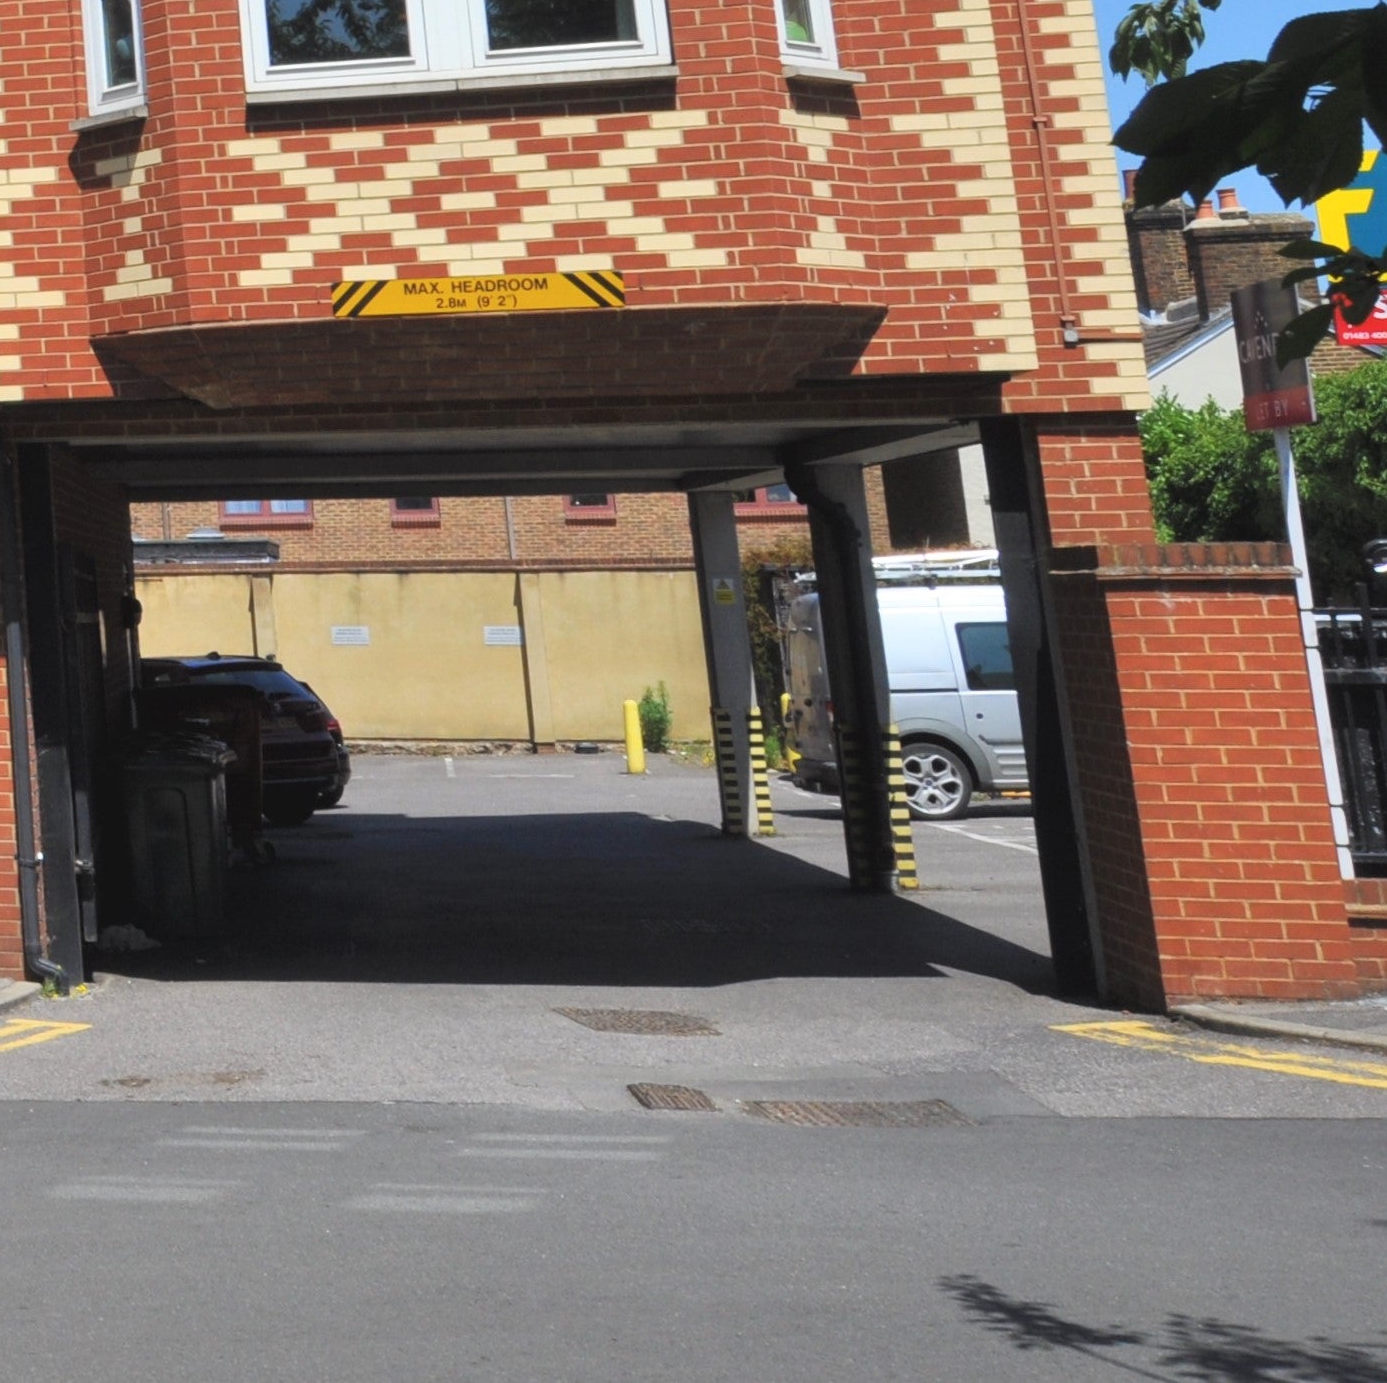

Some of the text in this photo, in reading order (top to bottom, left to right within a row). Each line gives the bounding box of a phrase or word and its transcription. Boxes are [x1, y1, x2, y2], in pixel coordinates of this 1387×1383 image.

[403, 278, 548, 295] MAX. HEADROOM
[436, 297, 467, 309] 2.8M
